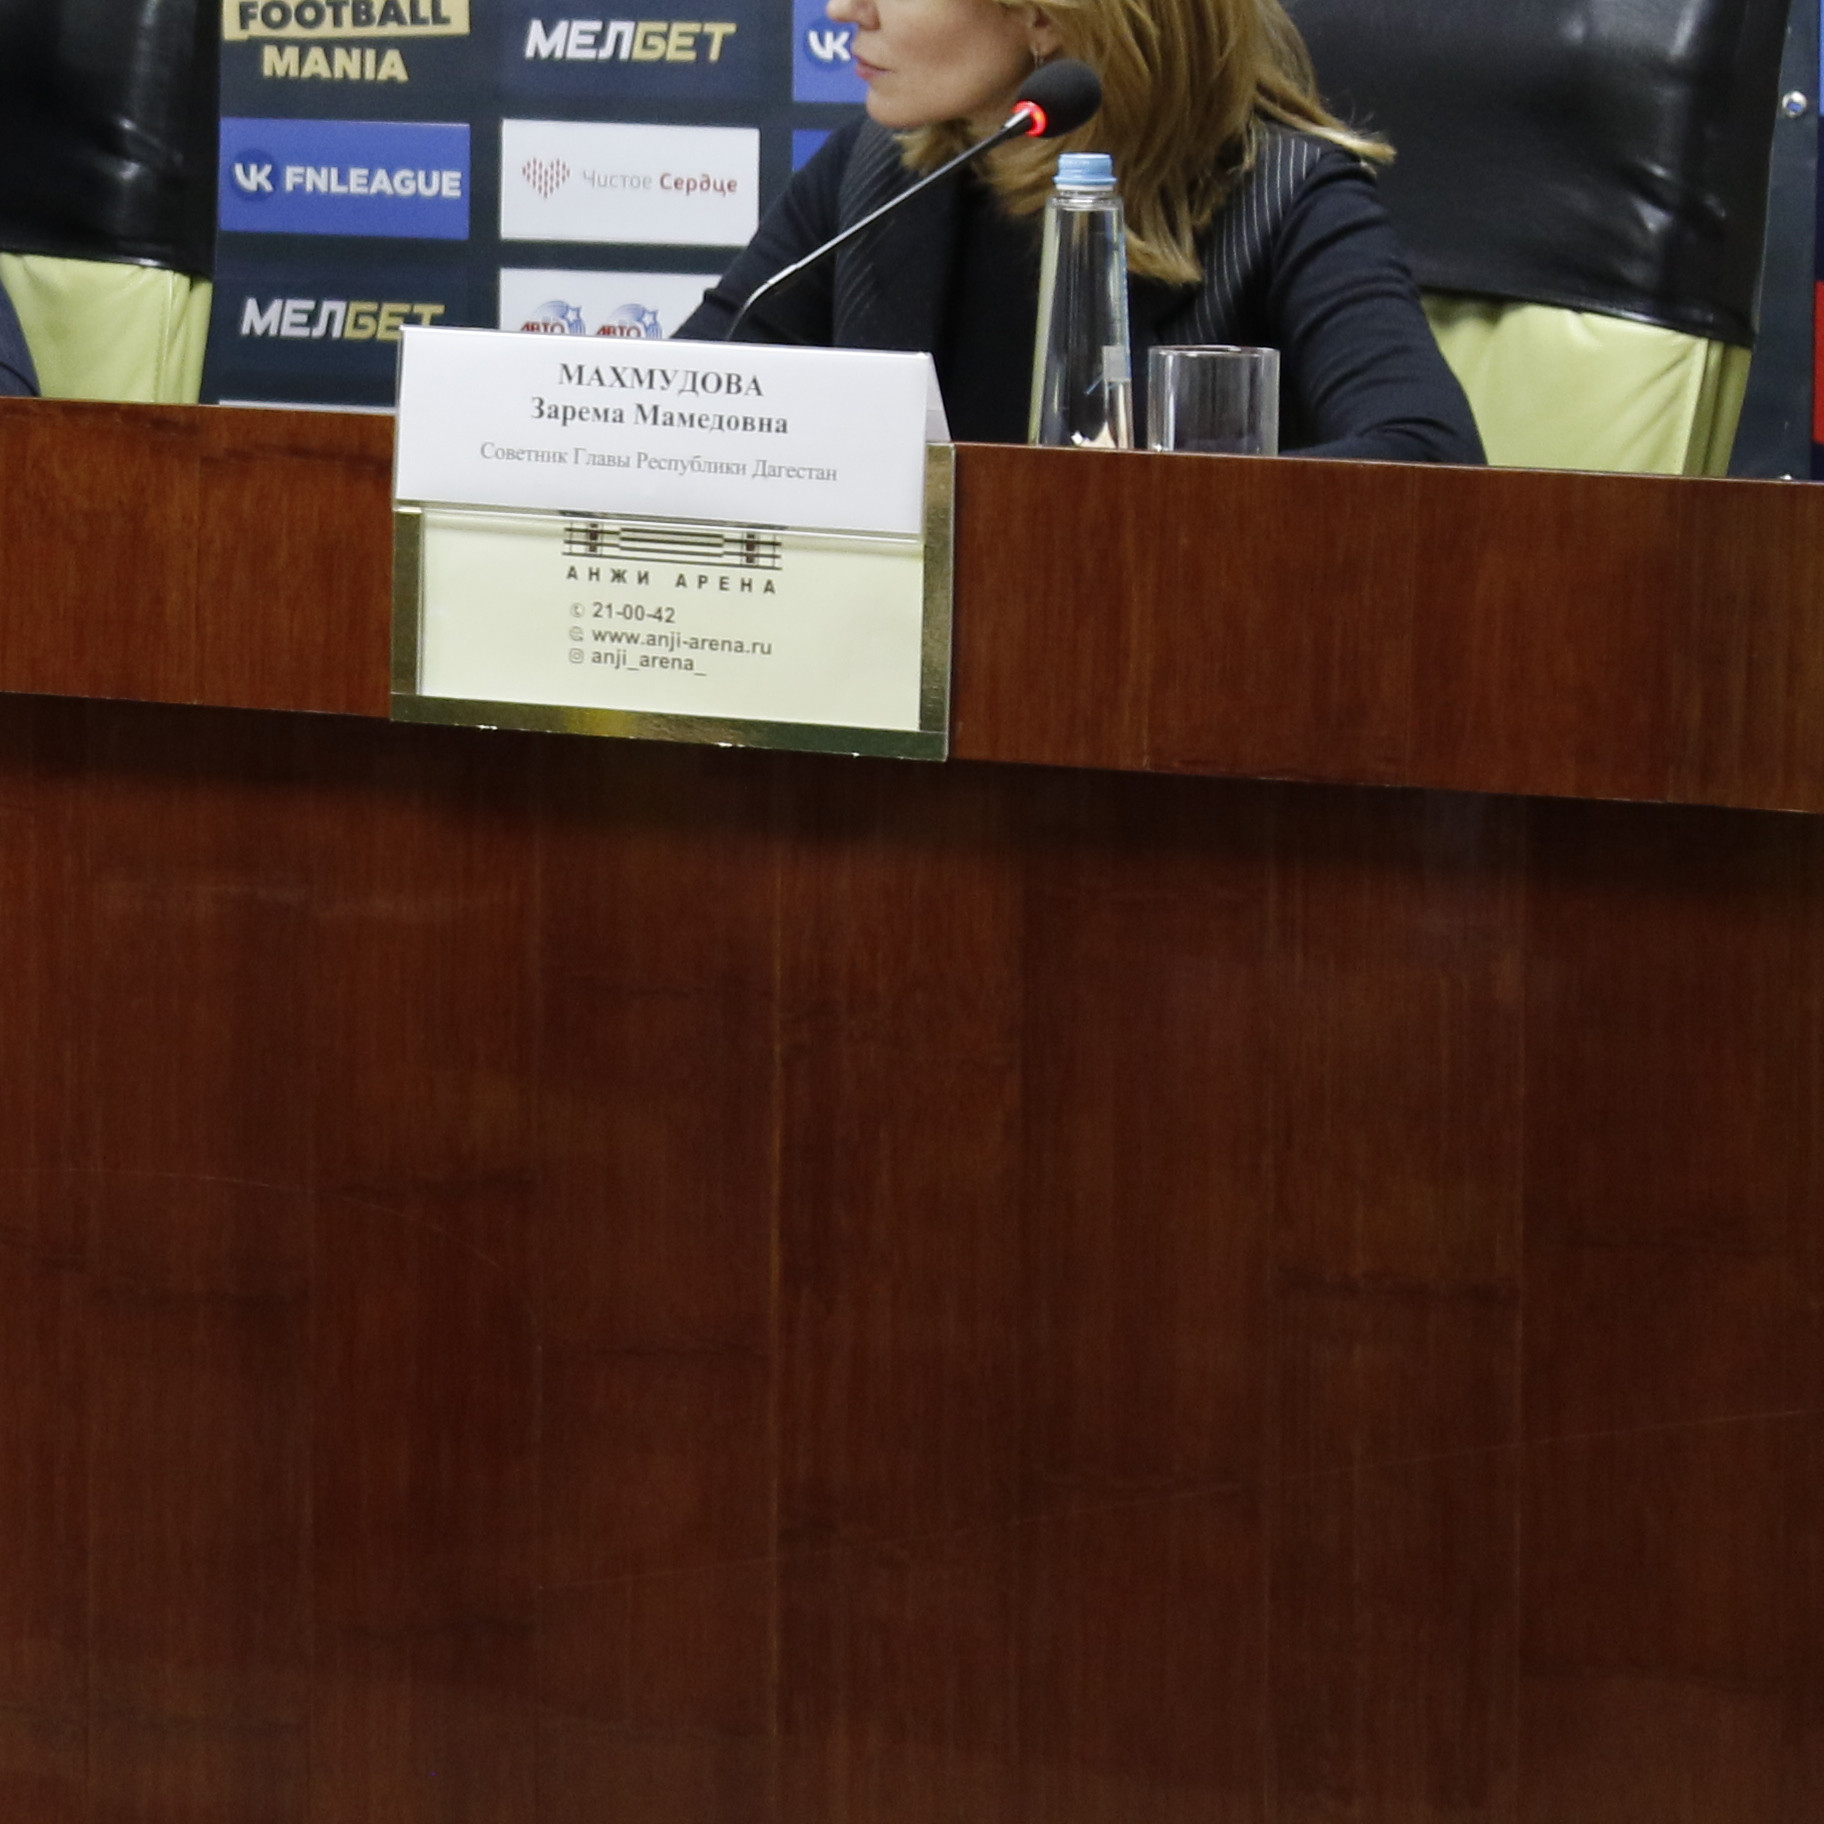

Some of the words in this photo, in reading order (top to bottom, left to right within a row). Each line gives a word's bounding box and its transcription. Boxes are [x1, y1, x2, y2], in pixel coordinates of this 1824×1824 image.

[525, 20, 736, 62] МЕЛБЕТ
[262, 46, 408, 81] MANIA
[285, 167, 461, 196] FNLEAGUE
[659, 173, 738, 195] Сердце
[558, 364, 764, 397] МАХМУДОВА
[530, 397, 625, 425] Зарема
[634, 404, 788, 434] Мамедовна
[481, 443, 568, 464] Советник
[574, 448, 630, 467] Главы
[637, 452, 746, 477] Республики
[752, 459, 837, 481] Дагестан
[567, 567, 649, 585] АНЖИ
[676, 573, 775, 594] АРЕНА
[592, 603, 675, 623] 21-00-42
[592, 628, 771, 655] www.anji-arena.ru
[592, 649, 705, 675] anji_arena_
